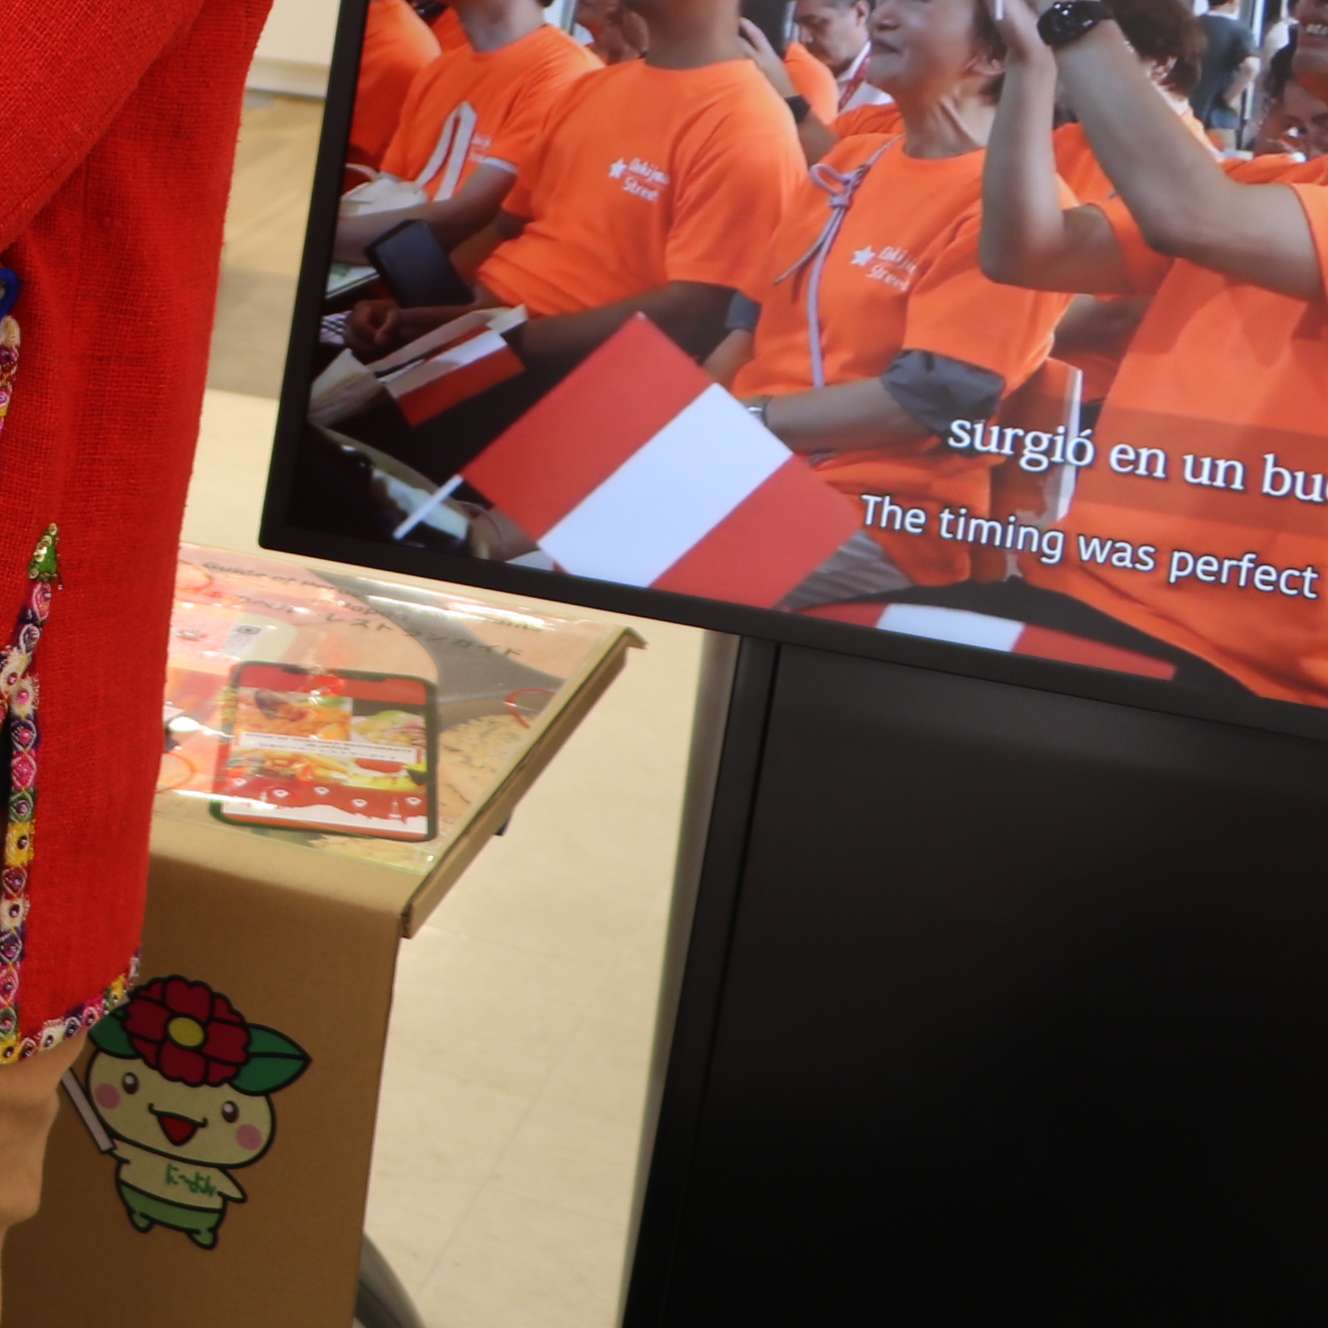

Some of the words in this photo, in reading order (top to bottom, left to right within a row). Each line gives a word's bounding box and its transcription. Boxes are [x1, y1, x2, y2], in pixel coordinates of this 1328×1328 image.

[623, 176, 660, 202] Street
[947, 417, 1095, 472] surgió
[1109, 443, 1166, 479] en
[1183, 454, 1245, 491] un
[1262, 453, 1328, 502] bu
[860, 493, 927, 534] The
[938, 508, 1064, 564] timing
[1077, 532, 1156, 572] was
[1169, 546, 1319, 600] perfect
